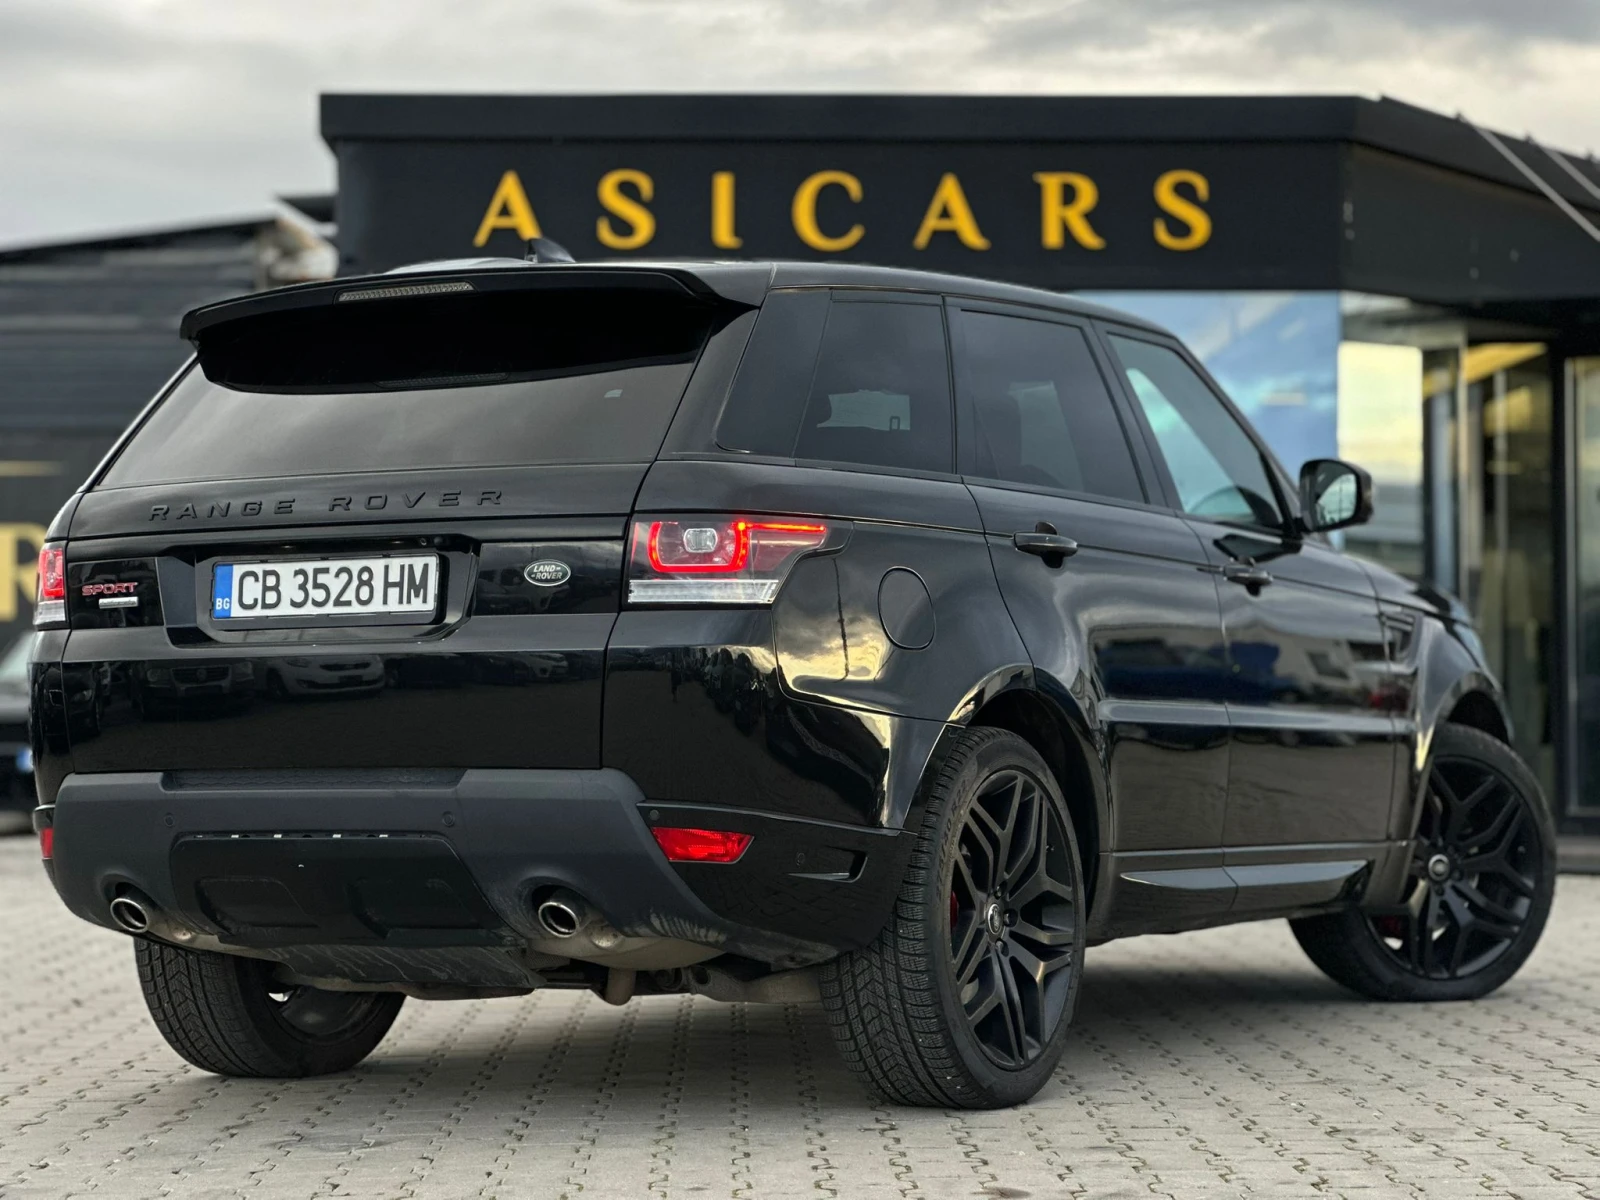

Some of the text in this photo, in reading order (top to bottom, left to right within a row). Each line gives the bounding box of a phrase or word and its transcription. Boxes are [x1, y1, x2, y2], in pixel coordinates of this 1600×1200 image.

[473, 168, 1213, 251] ASICARS
[149, 490, 503, 521] RANGE ROVER
[82, 581, 139, 596] SPORT
[237, 562, 430, 611] CB 3528 HM
[215, 597, 231, 611] BG
